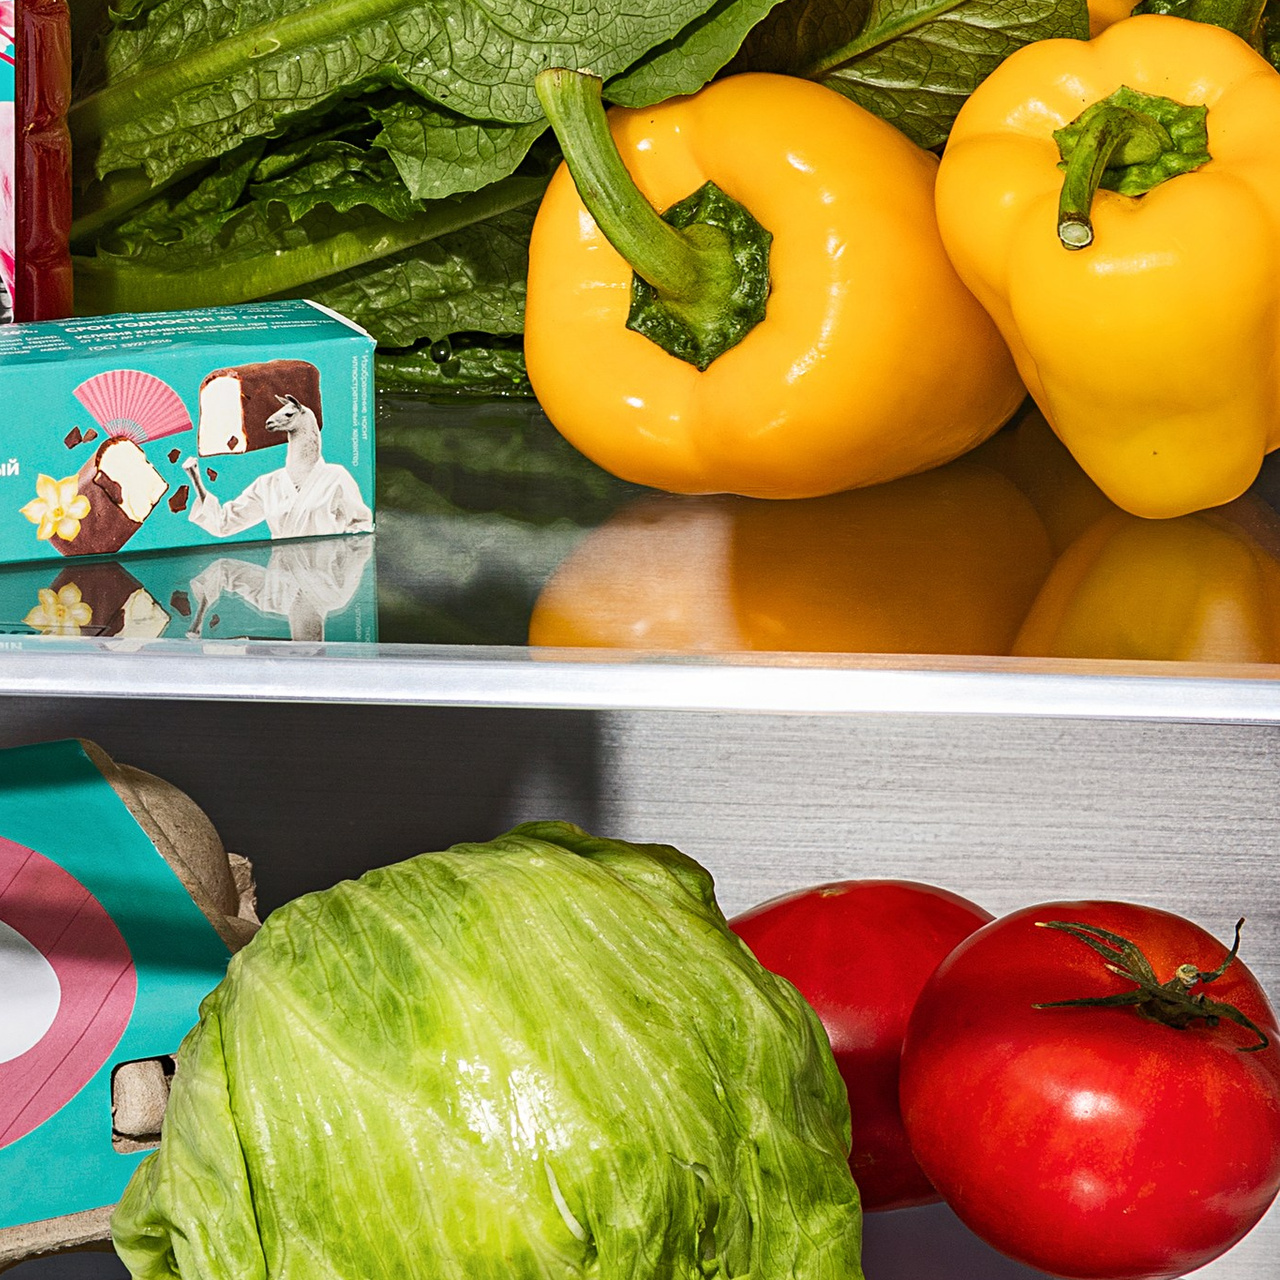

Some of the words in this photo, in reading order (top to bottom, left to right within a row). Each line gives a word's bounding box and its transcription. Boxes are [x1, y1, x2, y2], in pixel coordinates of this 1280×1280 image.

[64, 324, 113, 332] СРОК
[115, 317, 215, 328] ГОДНОСТИ:
[74, 330, 132, 339] УСЛОВИЯ
